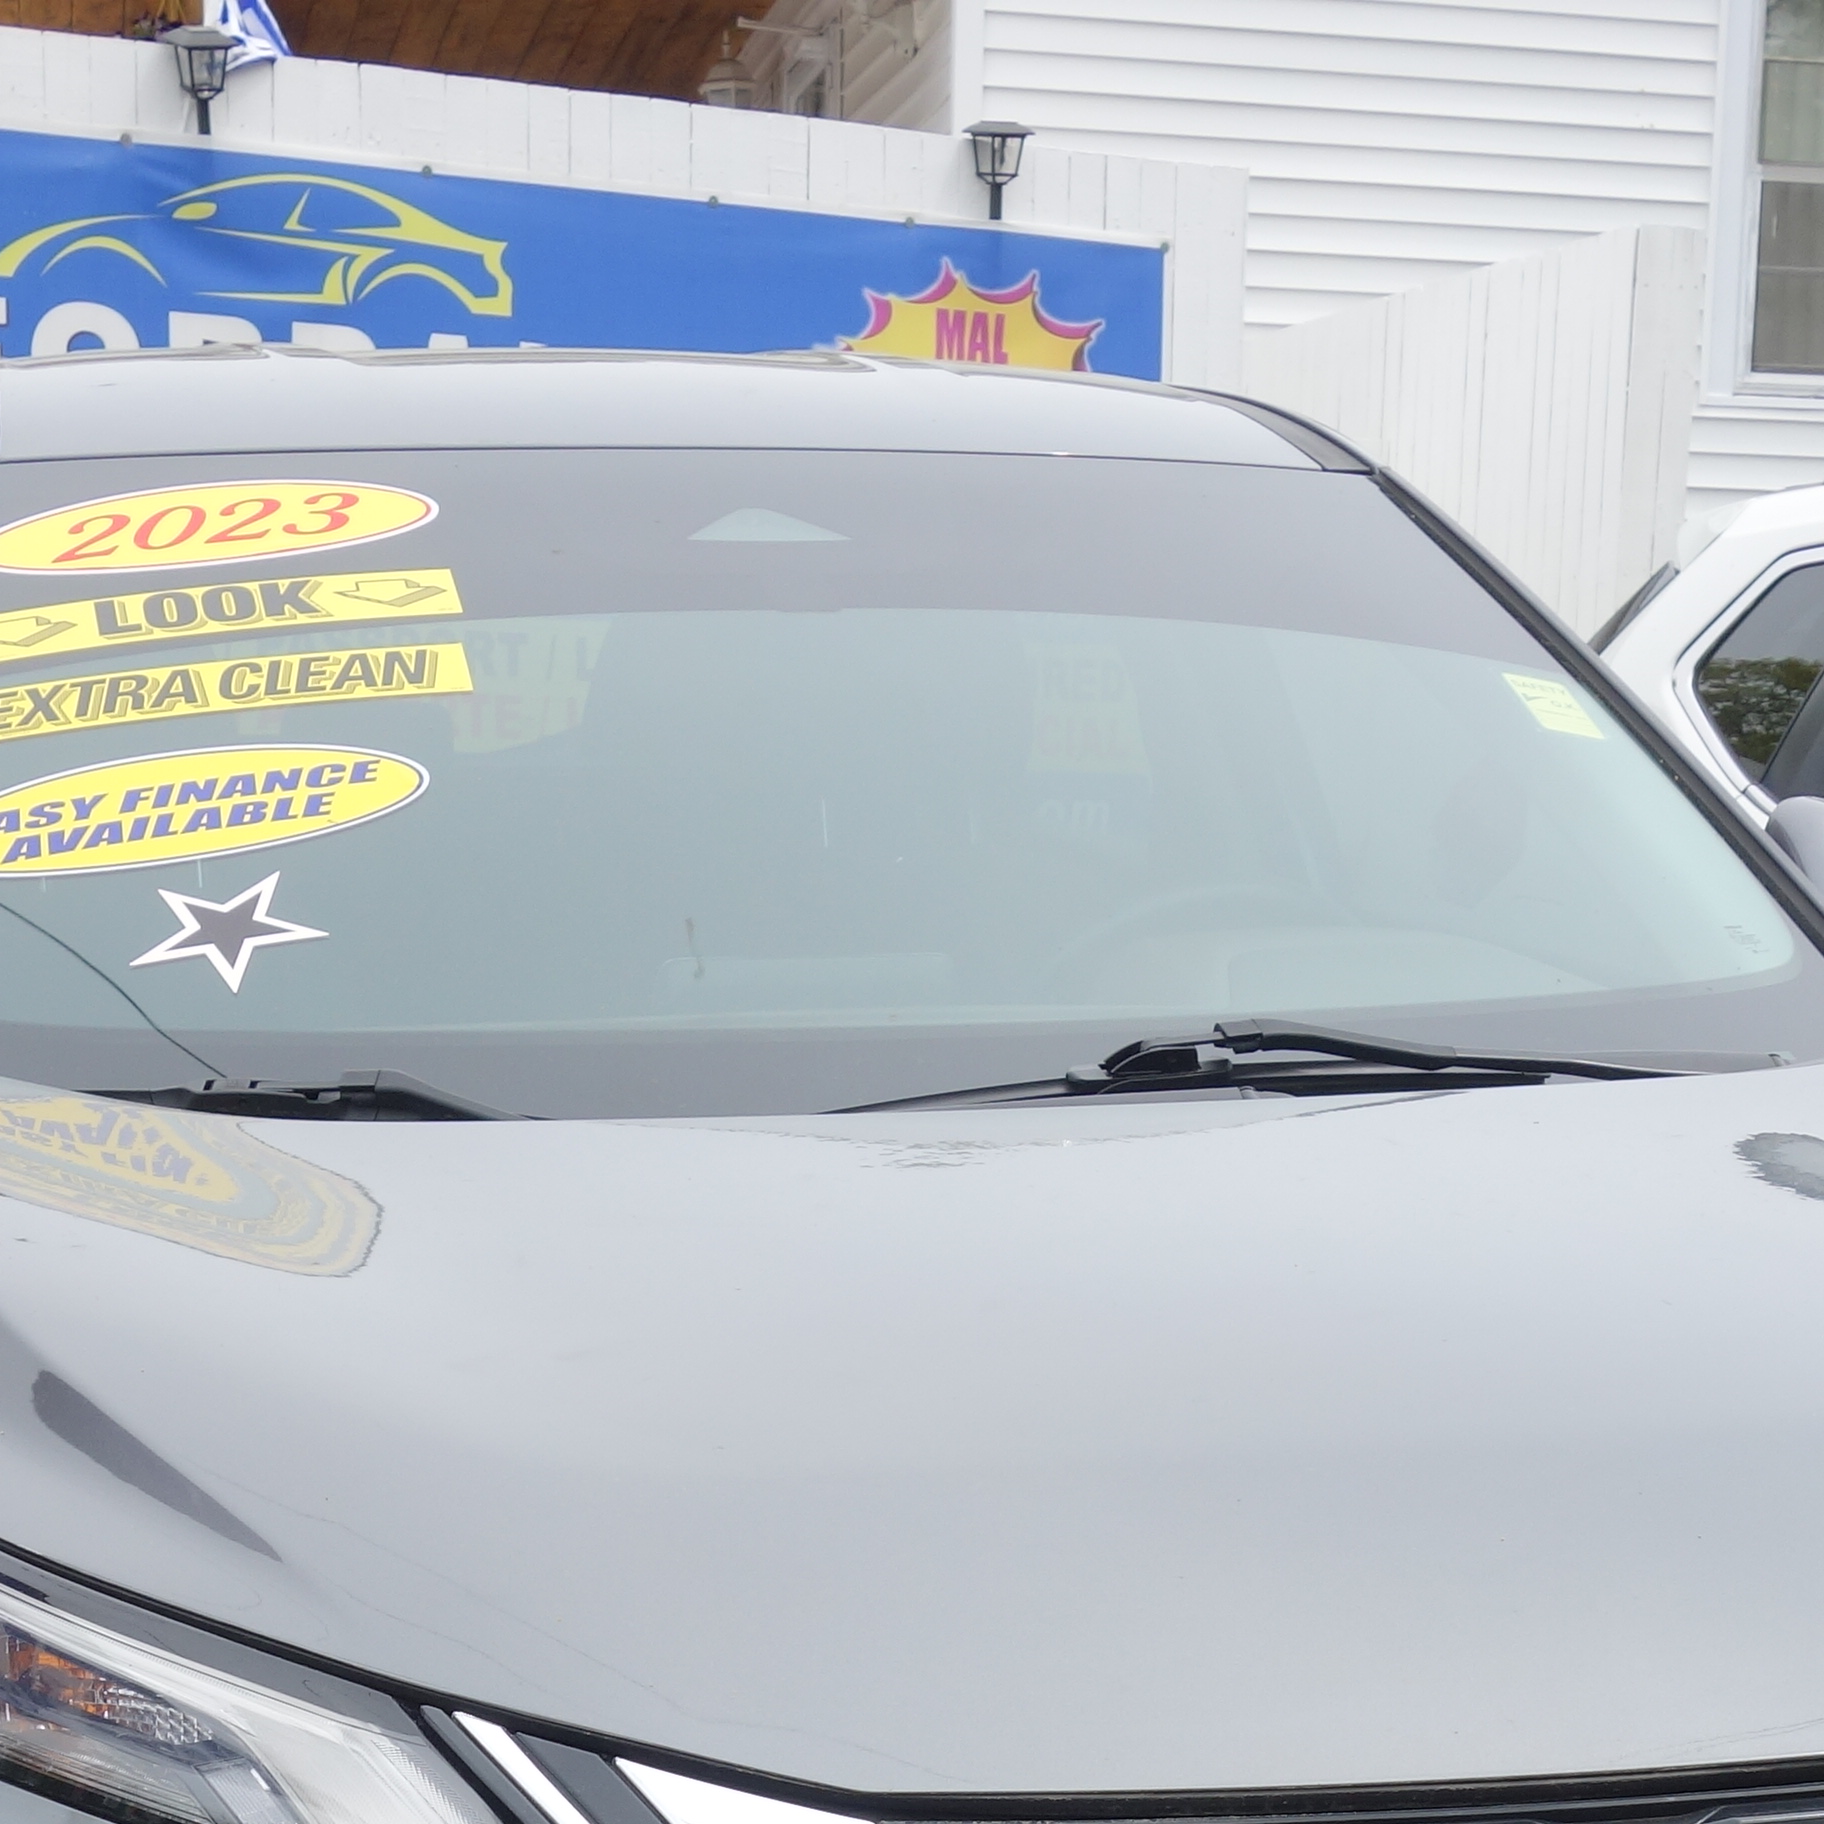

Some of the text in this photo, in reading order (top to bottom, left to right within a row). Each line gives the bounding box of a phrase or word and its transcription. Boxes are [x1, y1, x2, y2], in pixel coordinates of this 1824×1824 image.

[935, 307, 1009, 365] MAL
[52, 492, 360, 563] 2023
[93, 579, 328, 638] LOOK
[219, 648, 436, 701] CLEAN
[123, 759, 382, 815] FINANCE
[0, 793, 335, 864] AVAILABLE
